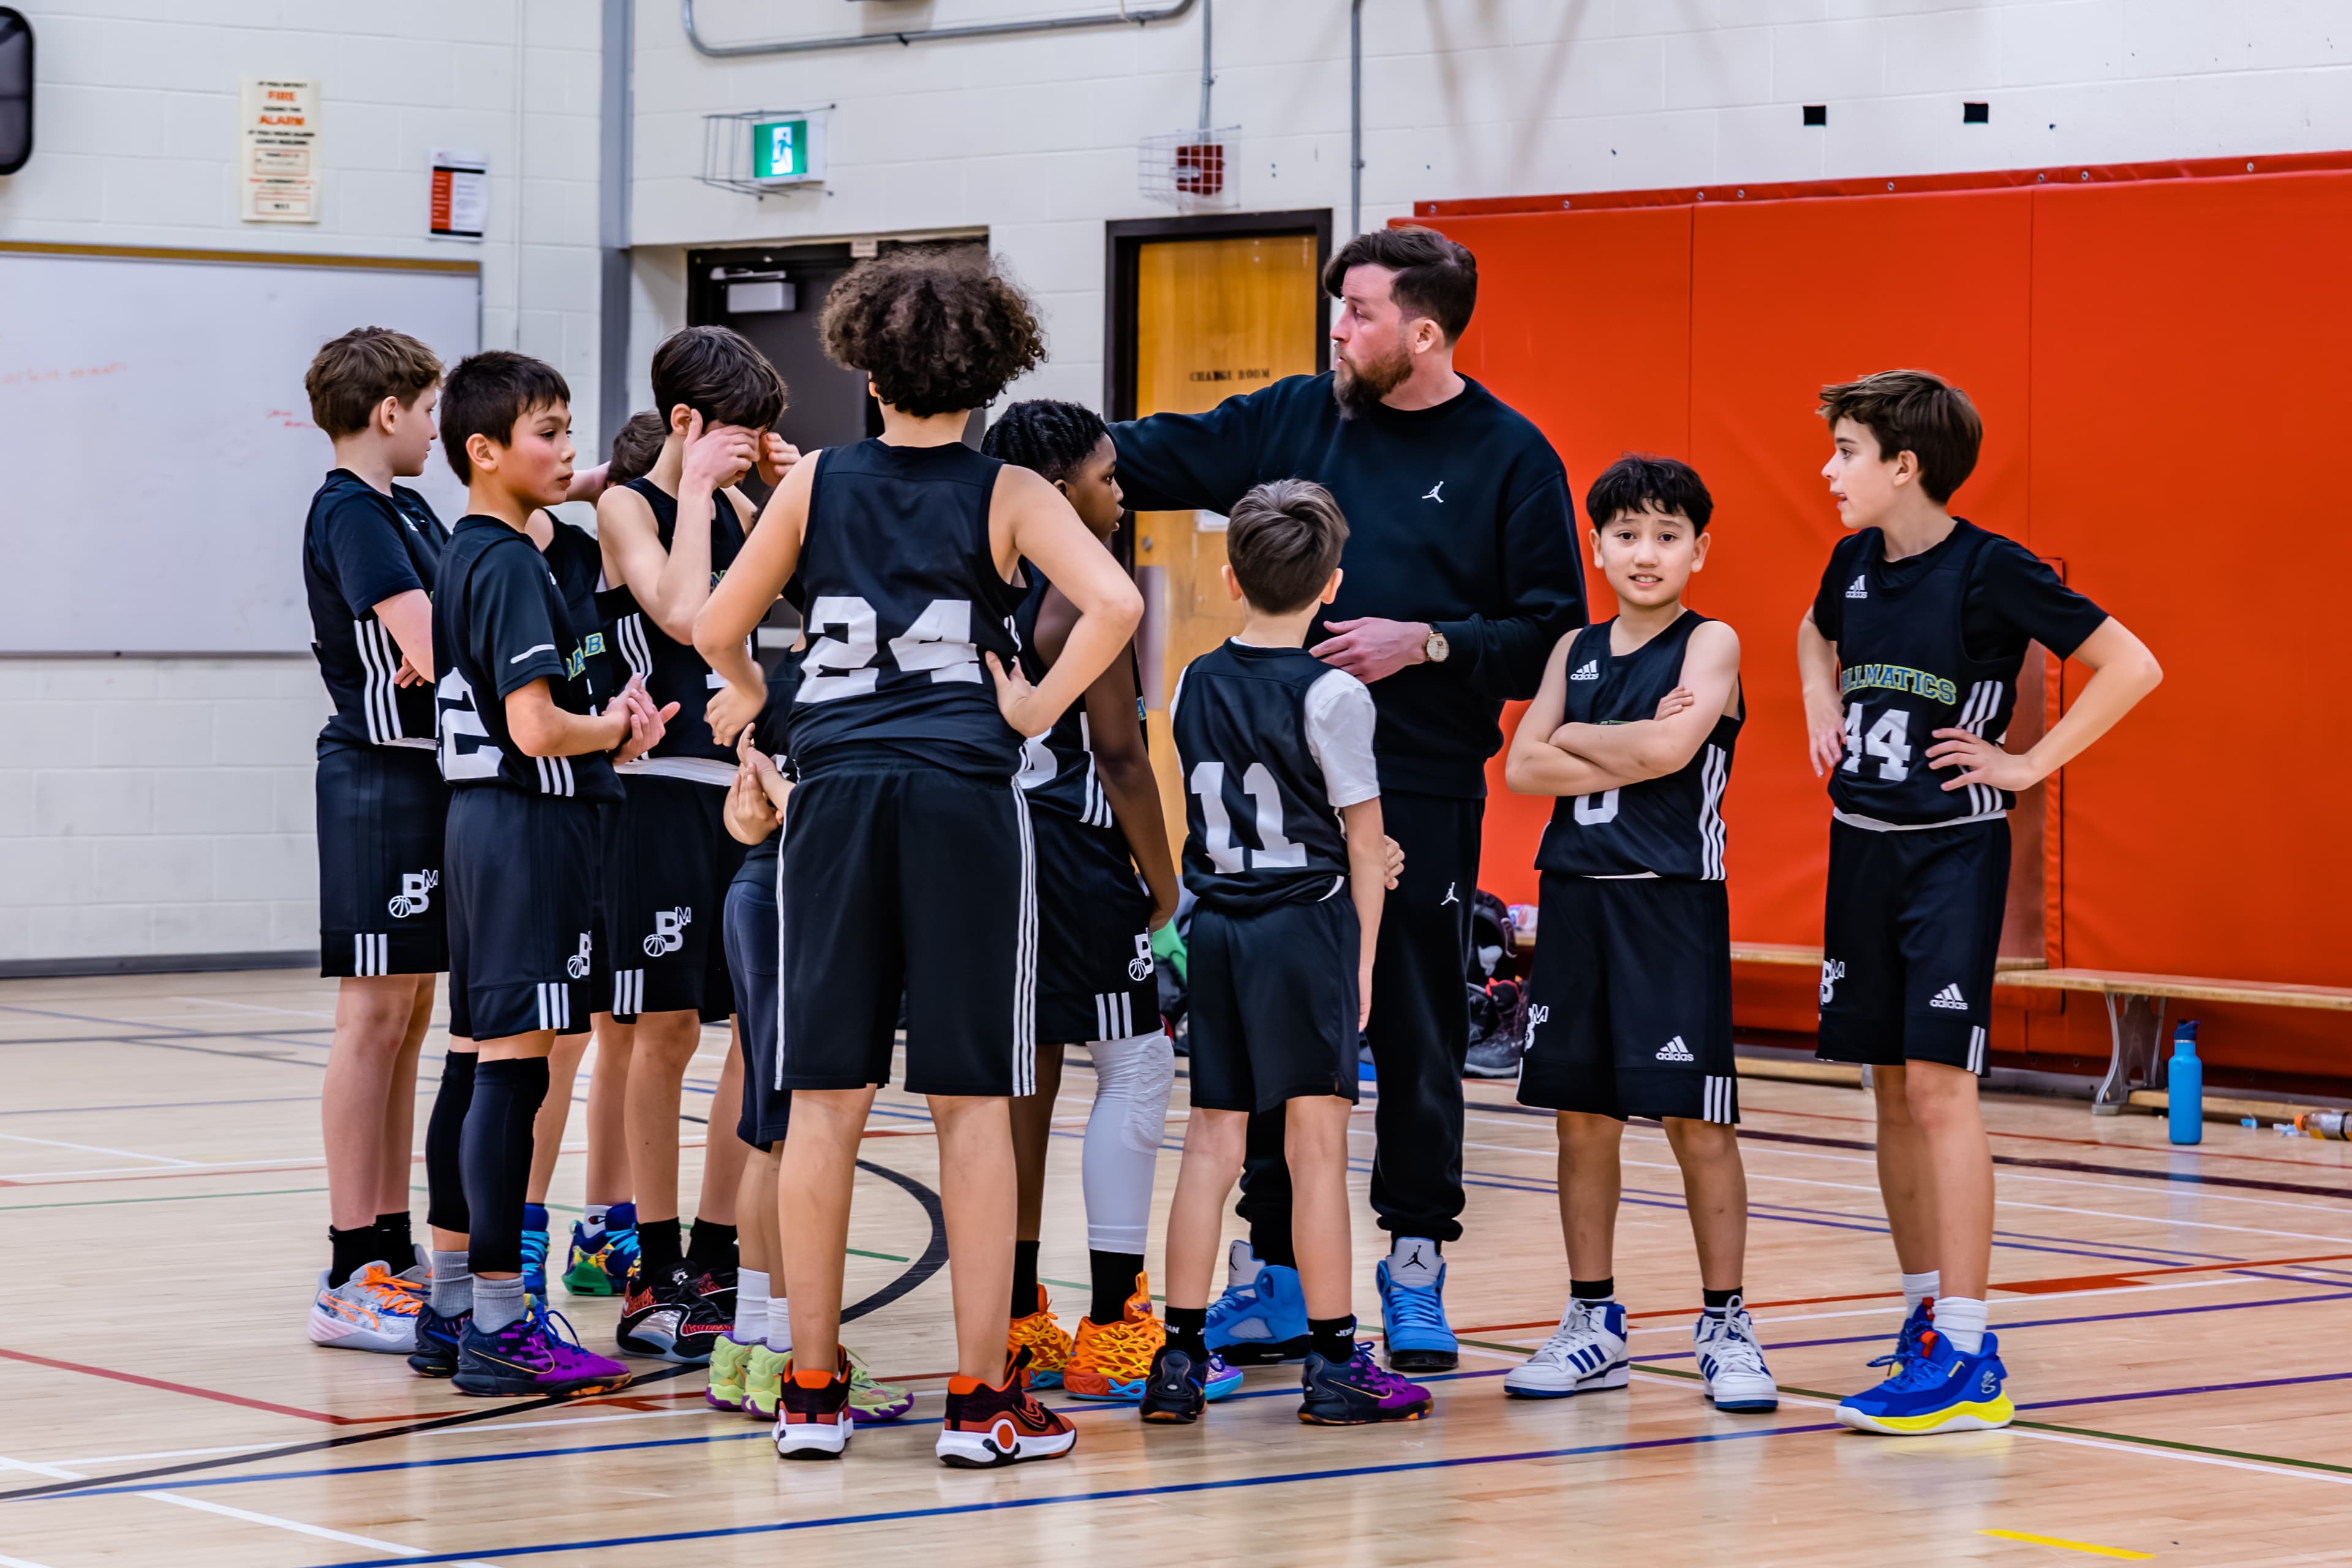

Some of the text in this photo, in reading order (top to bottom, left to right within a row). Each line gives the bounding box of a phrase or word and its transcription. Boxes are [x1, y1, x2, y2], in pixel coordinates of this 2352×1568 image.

[267, 90, 296, 102] FIRE
[258, 115, 305, 126] ALARM
[1189, 368, 1270, 381] CHANGE ROOM
[796, 596, 983, 703] 24
[1190, 761, 1308, 873] 11
[1929, 999, 1968, 1010] adidas
[1656, 1052, 1695, 1061] adidas
